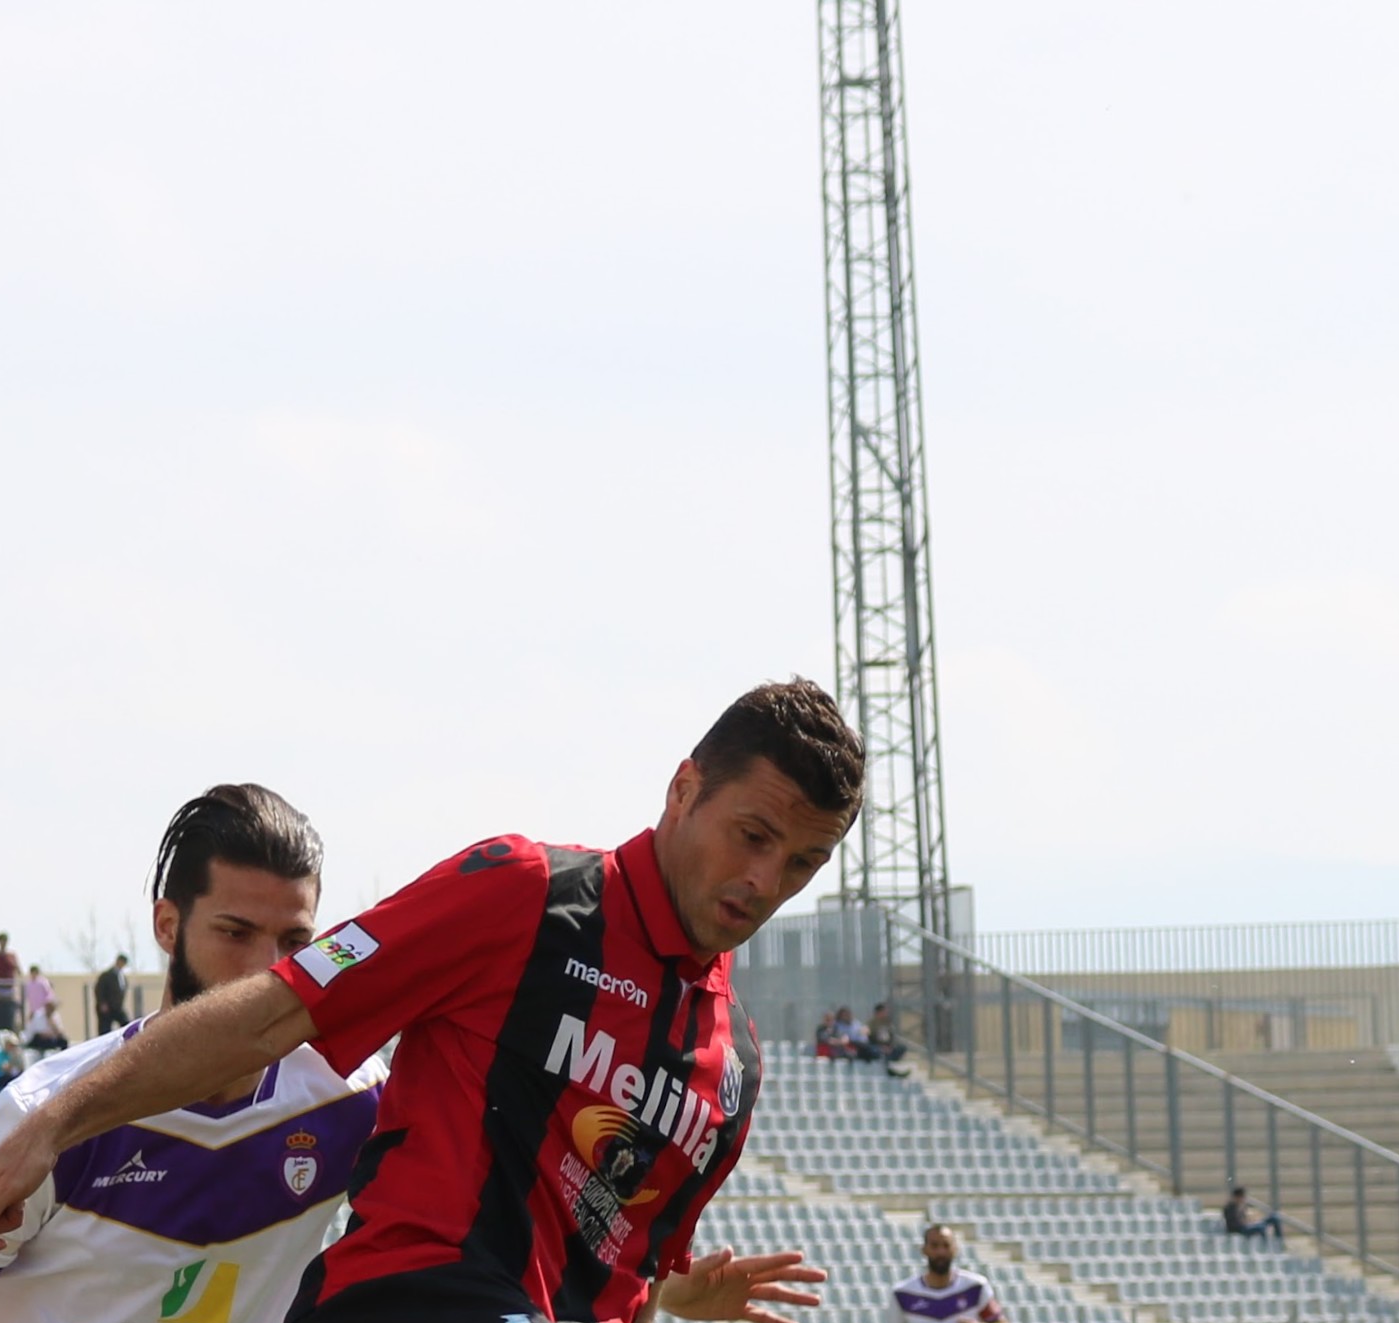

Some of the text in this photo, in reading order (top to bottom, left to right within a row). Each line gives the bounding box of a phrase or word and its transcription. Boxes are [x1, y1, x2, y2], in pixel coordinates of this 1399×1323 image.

[564, 957, 648, 1009] macron
[544, 1013, 719, 1175] Melilla
[92, 1170, 168, 1188] MERCURY
